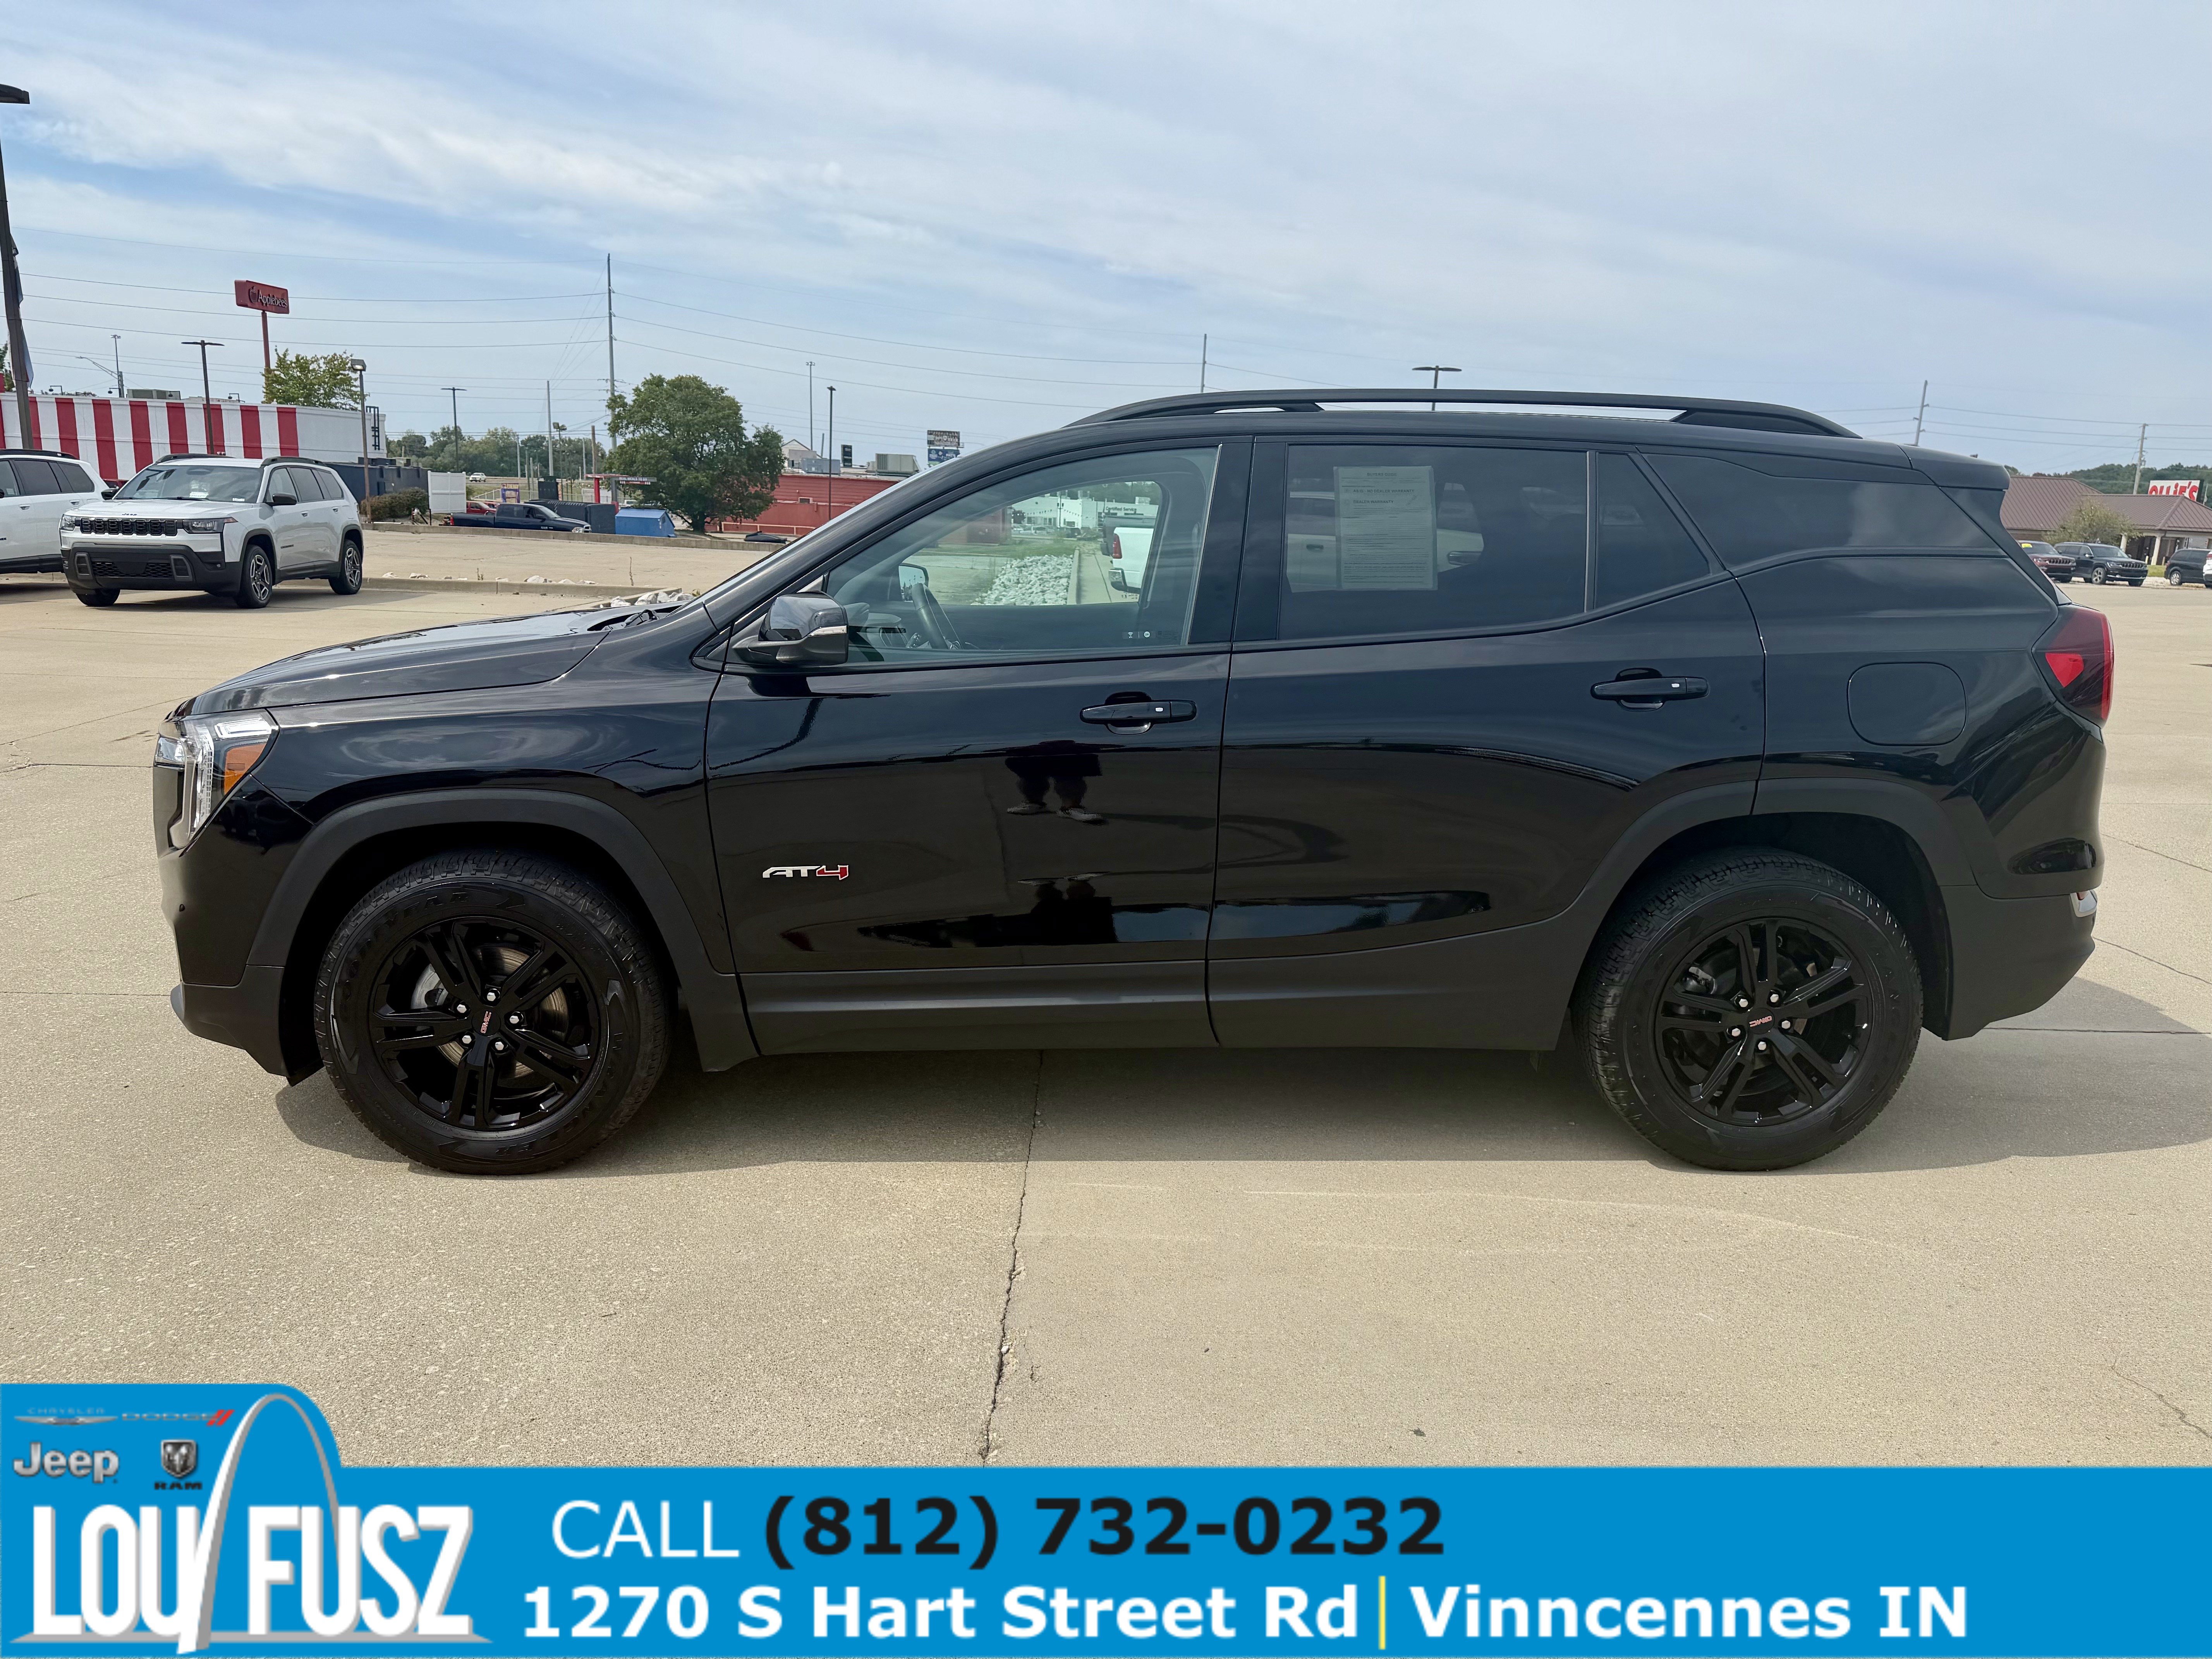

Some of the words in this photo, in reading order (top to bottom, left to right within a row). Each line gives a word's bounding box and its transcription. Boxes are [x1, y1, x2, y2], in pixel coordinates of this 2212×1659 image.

[763, 865, 848, 880] AT4
[481, 1011, 491, 1034] GMC
[1749, 1016, 1772, 1027] GMC
